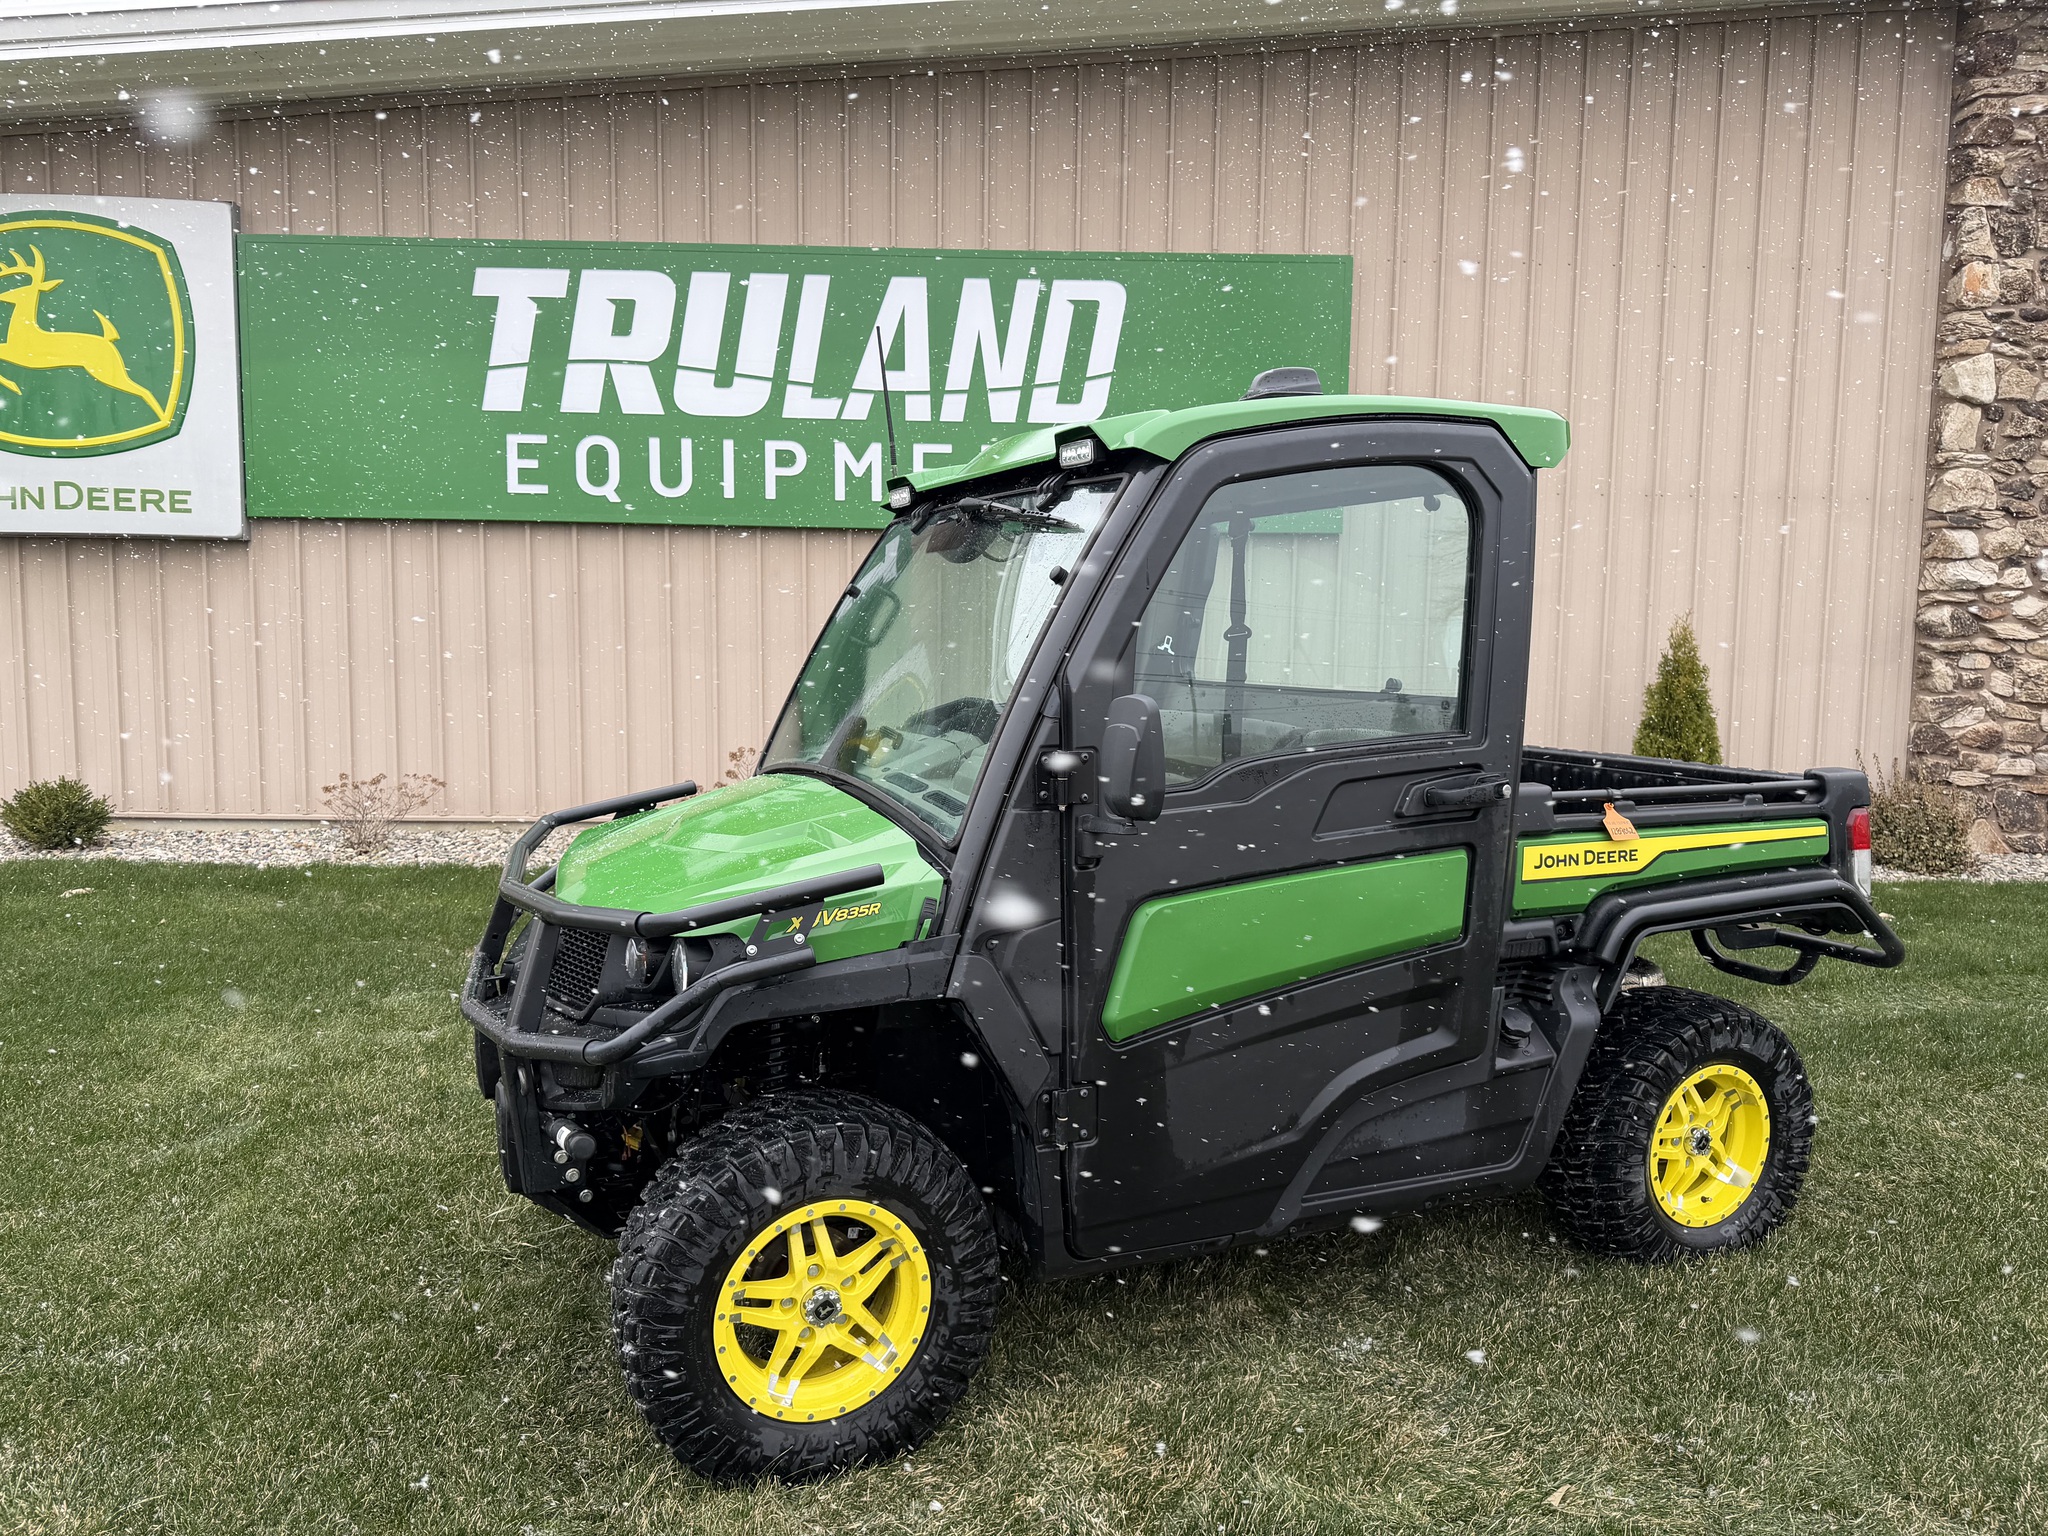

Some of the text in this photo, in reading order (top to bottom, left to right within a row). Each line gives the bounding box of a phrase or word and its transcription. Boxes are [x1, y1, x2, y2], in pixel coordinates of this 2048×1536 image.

[471, 267, 1127, 424] TRULAND
[505, 433, 991, 502] EQUIPM
[0, 480, 193, 514] HN DEERE
[1534, 849, 1638, 870] JOHN DEERE
